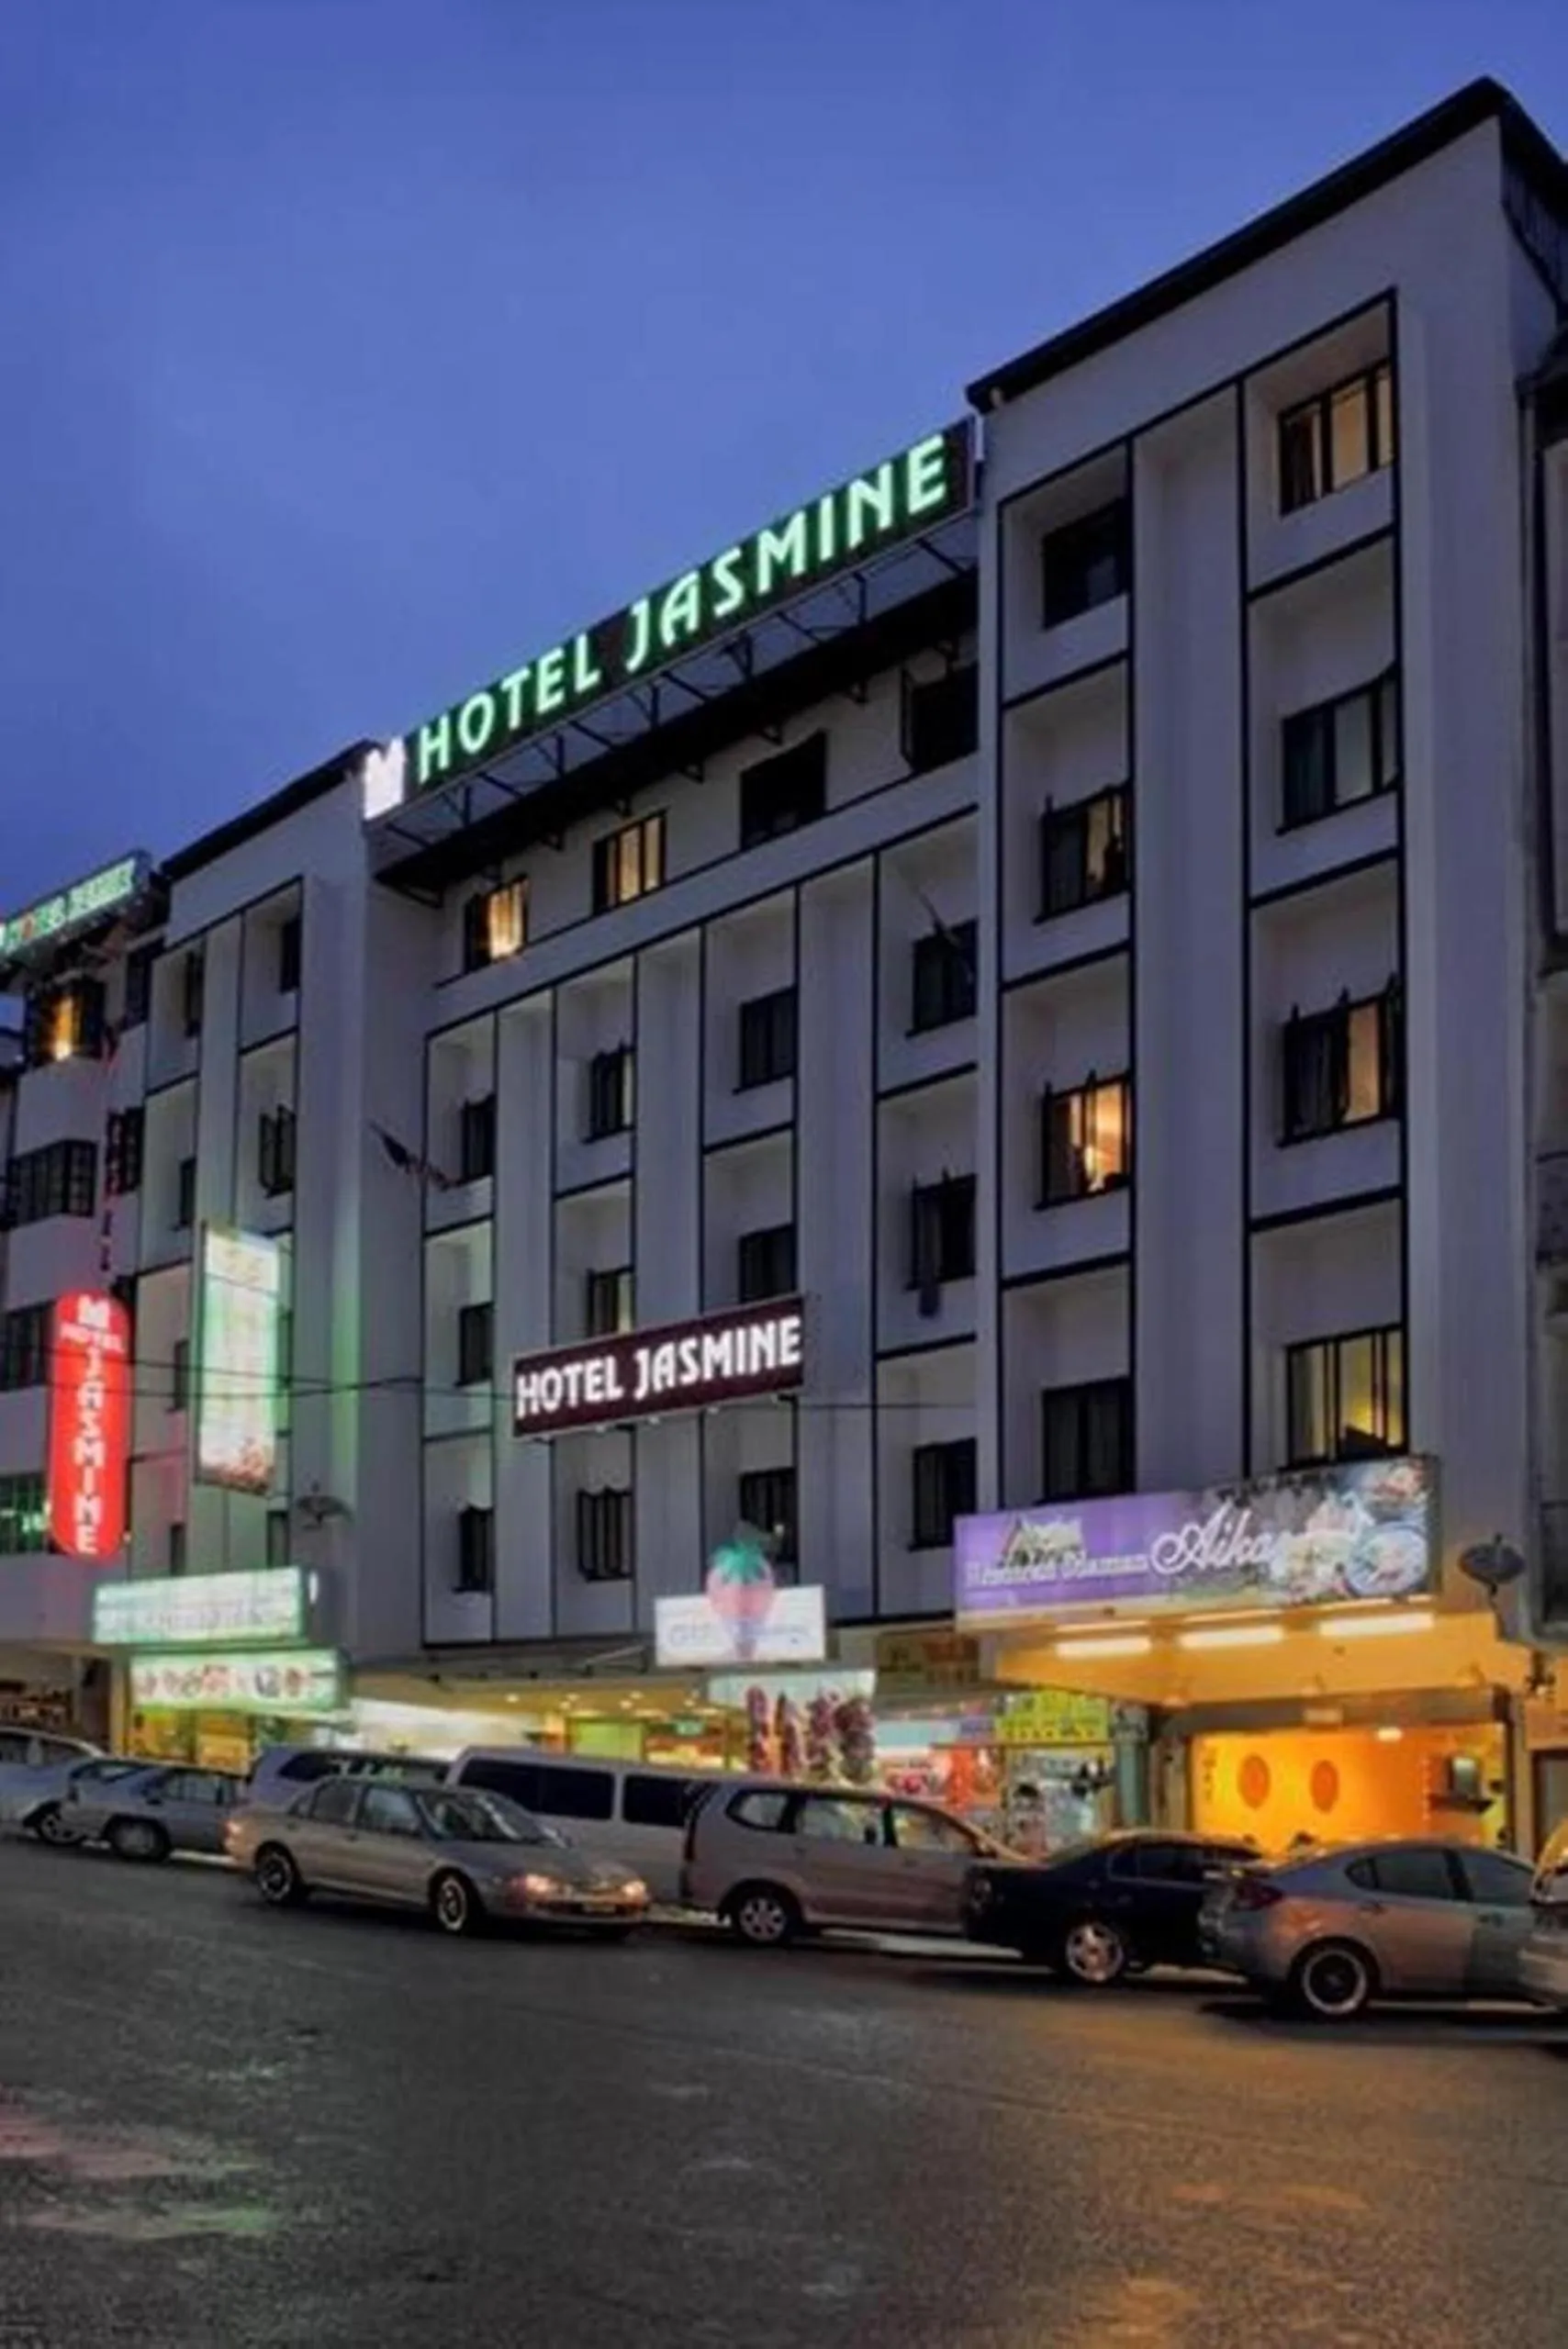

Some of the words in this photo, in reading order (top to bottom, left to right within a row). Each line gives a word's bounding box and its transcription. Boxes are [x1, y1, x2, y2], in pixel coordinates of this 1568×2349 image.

[416, 633, 600, 783] HOTEL
[625, 434, 946, 672] JASMINE
[516, 1355, 624, 1419] HOTEL
[633, 1315, 802, 1402] JASMINE
